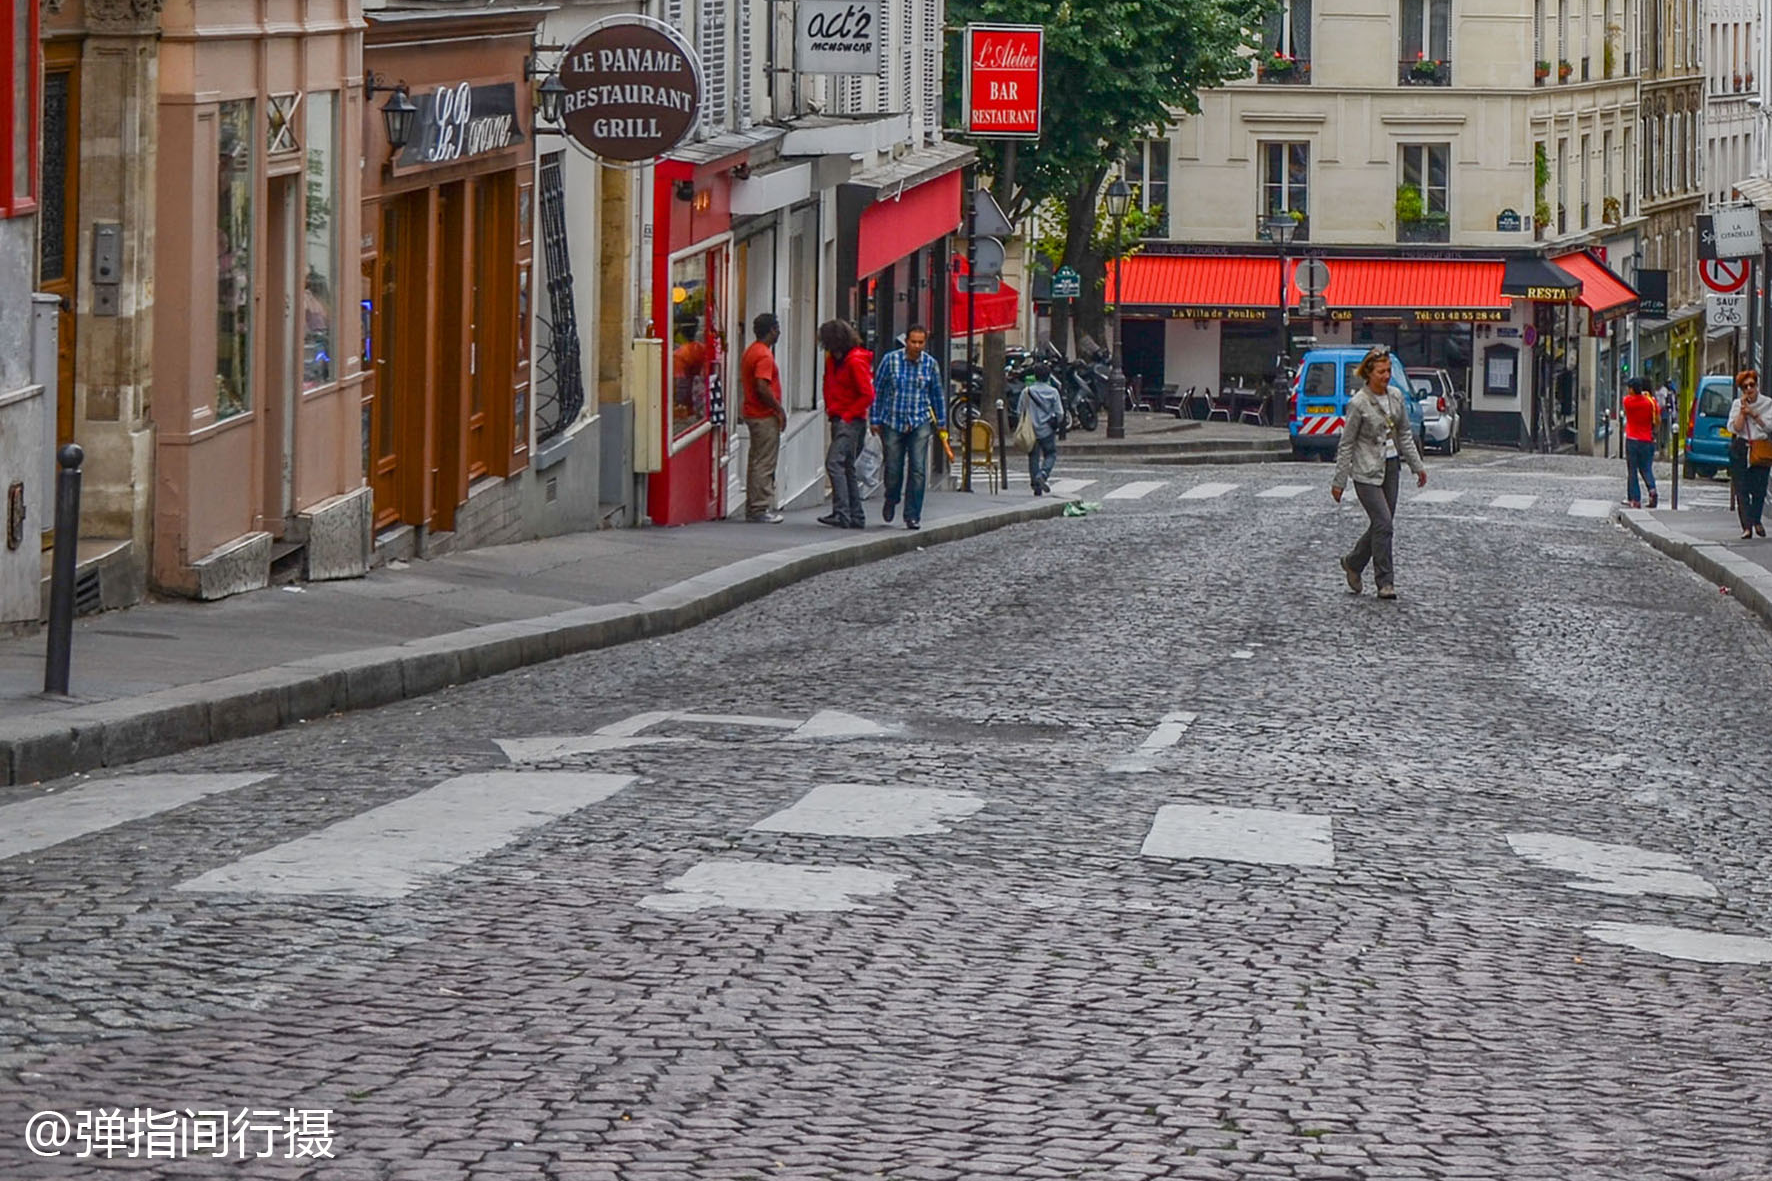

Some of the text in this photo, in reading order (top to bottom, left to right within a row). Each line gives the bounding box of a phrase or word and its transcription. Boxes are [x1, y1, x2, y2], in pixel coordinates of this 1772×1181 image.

[572, 48, 682, 73] LE PANAME
[973, 38, 1037, 67] L'Atelier
[565, 85, 692, 113] RESTAURANT
[990, 82, 1018, 100] BAR
[972, 109, 1036, 124] RESTAURANT
[593, 119, 662, 138] GRILL
[1716, 298, 1740, 306] SAUF
[1172, 309, 1185, 318] La
[1331, 311, 1352, 319] Café
